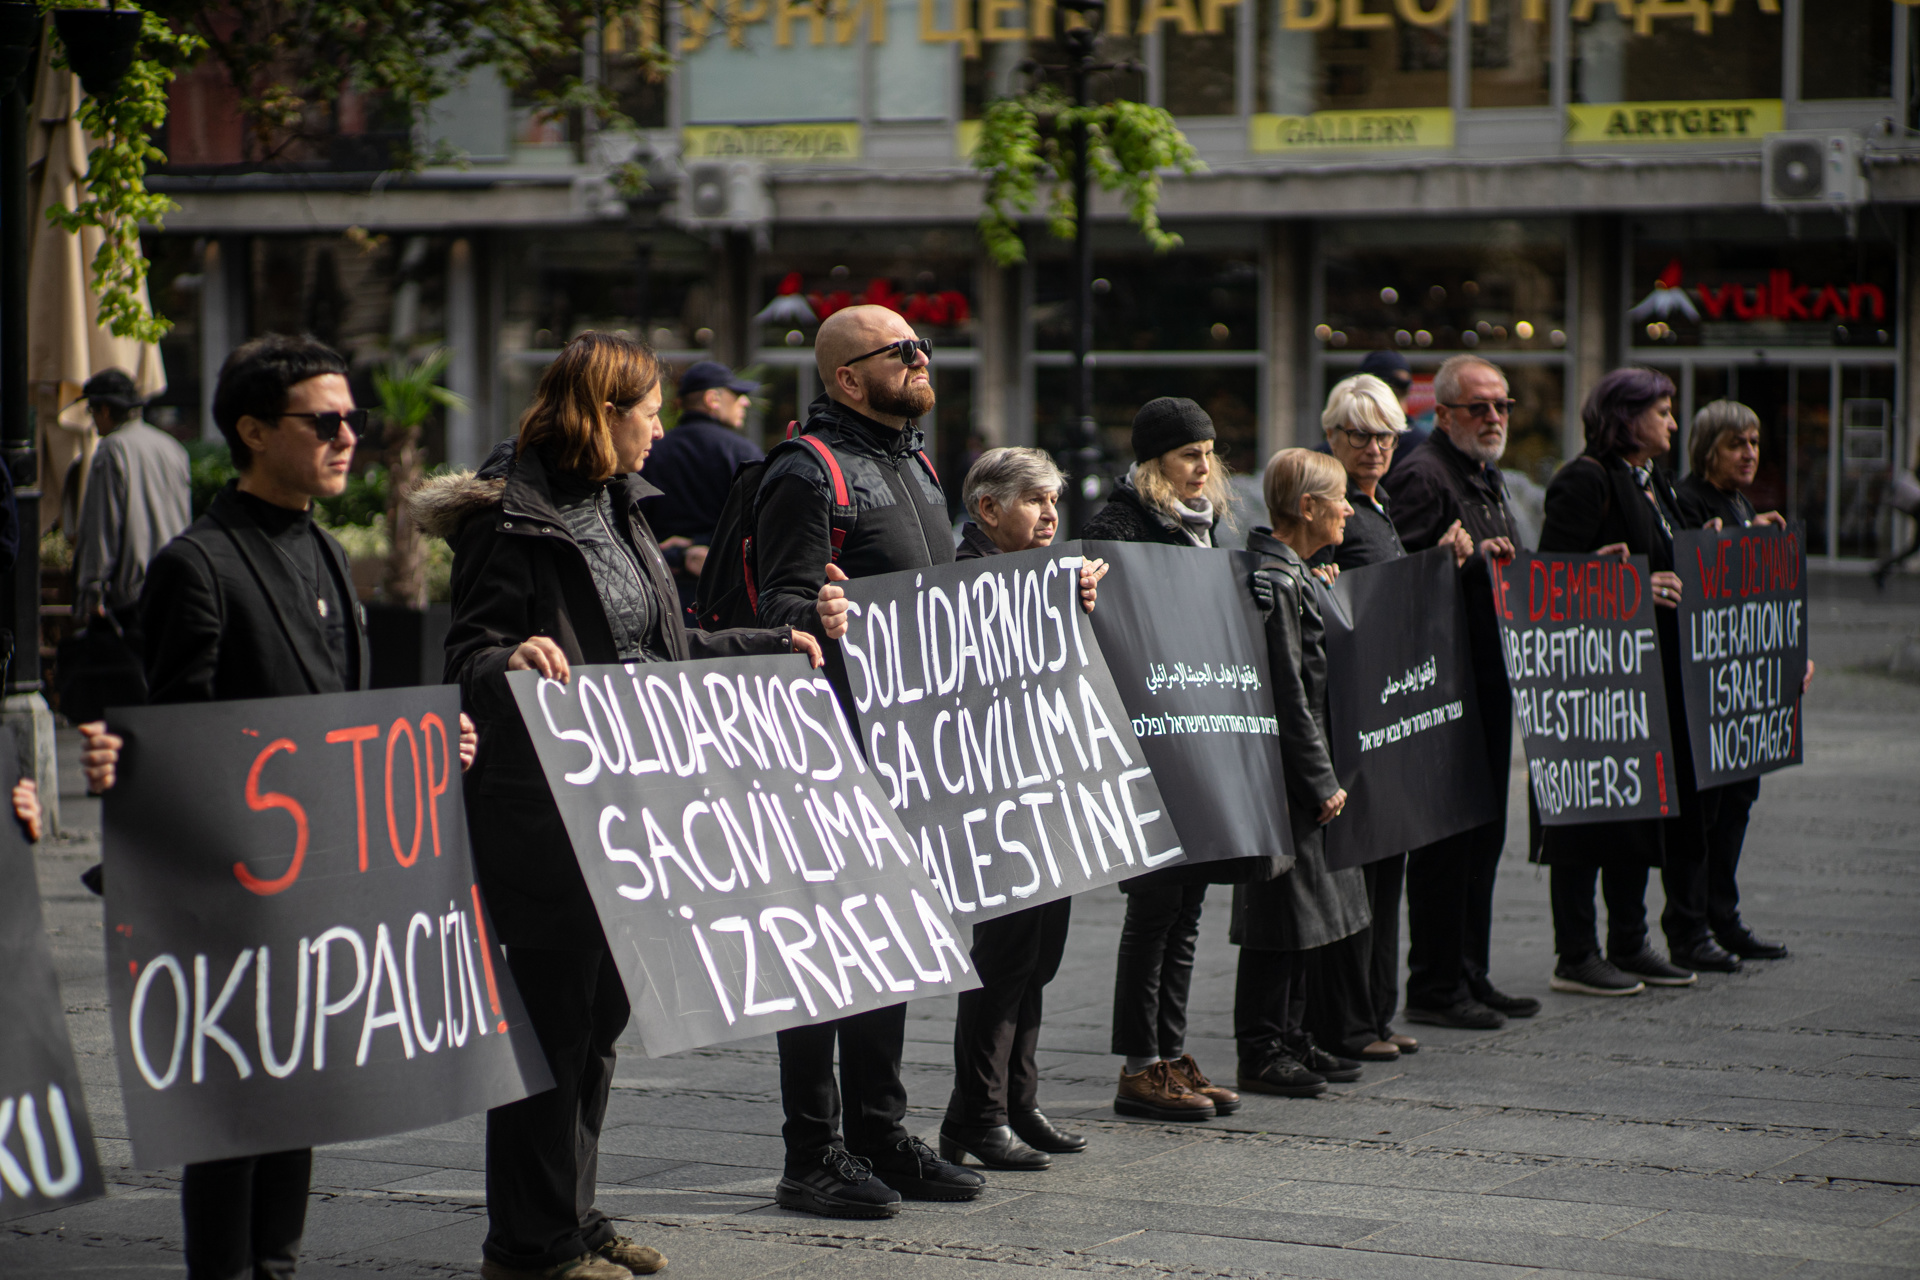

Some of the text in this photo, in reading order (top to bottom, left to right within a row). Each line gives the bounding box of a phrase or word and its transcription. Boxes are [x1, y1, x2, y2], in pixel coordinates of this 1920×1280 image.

[1604, 107, 1756, 138] ARTGET
[1529, 559, 1642, 622] DEMAND
[1696, 532, 1800, 600] WE DEMAND
[841, 556, 1090, 714] SOLIDARNOST
[1619, 627, 1656, 675] OF
[1691, 598, 1802, 662] LIBERATION OF
[1709, 656, 1781, 718] ISRAELI
[537, 663, 866, 785] SOLIDARNOST
[871, 674, 1133, 810] SA CIVILIMA
[1131, 713, 1166, 737] ופלס
[233, 712, 450, 896] STOP
[1530, 755, 1642, 815] PRISONERS
[905, 767, 1184, 915] ALESTINE
[679, 888, 970, 1026] IZRAELA
